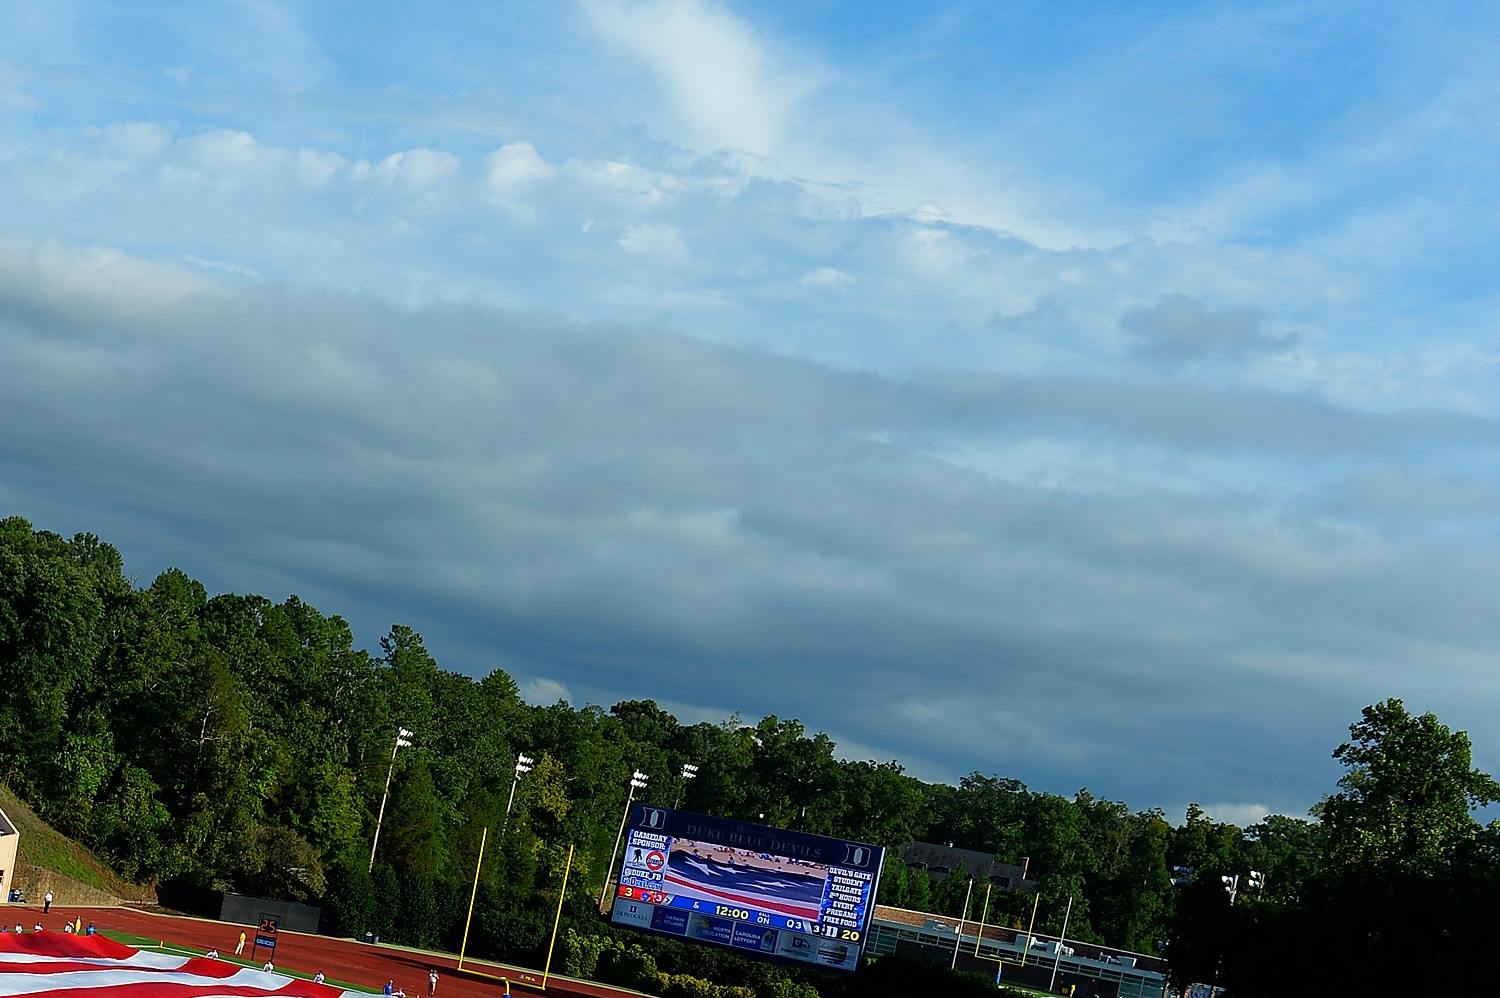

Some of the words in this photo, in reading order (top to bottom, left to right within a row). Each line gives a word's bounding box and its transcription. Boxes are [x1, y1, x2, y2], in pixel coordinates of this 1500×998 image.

[633, 830, 668, 843] GAMEDAY
[687, 824, 725, 840] DUKE
[730, 832, 765, 847] BLUE
[770, 840, 821, 858] DEVILS
[829, 867, 854, 878] DEVIL'S
[854, 871, 872, 881] GATE
[833, 876, 864, 887] STUDENT
[625, 887, 633, 897] 3
[831, 884, 863, 896] TAILGATE
[656, 893, 662, 901] 3
[839, 893, 861, 904] HOURS
[833, 901, 854, 911] EVERY
[715, 905, 750, 920] 12:00
[826, 908, 858, 920] PREGAME
[757, 916, 770, 926] ON
[823, 916, 840, 926] FREE
[840, 918, 857, 928] FOOD
[713, 926, 731, 934] NORTH
[813, 925, 820, 933] 3
[733, 936, 757, 946] LOTTERY
[734, 930, 761, 941] CAROLINA
[841, 929, 860, 942] 20
